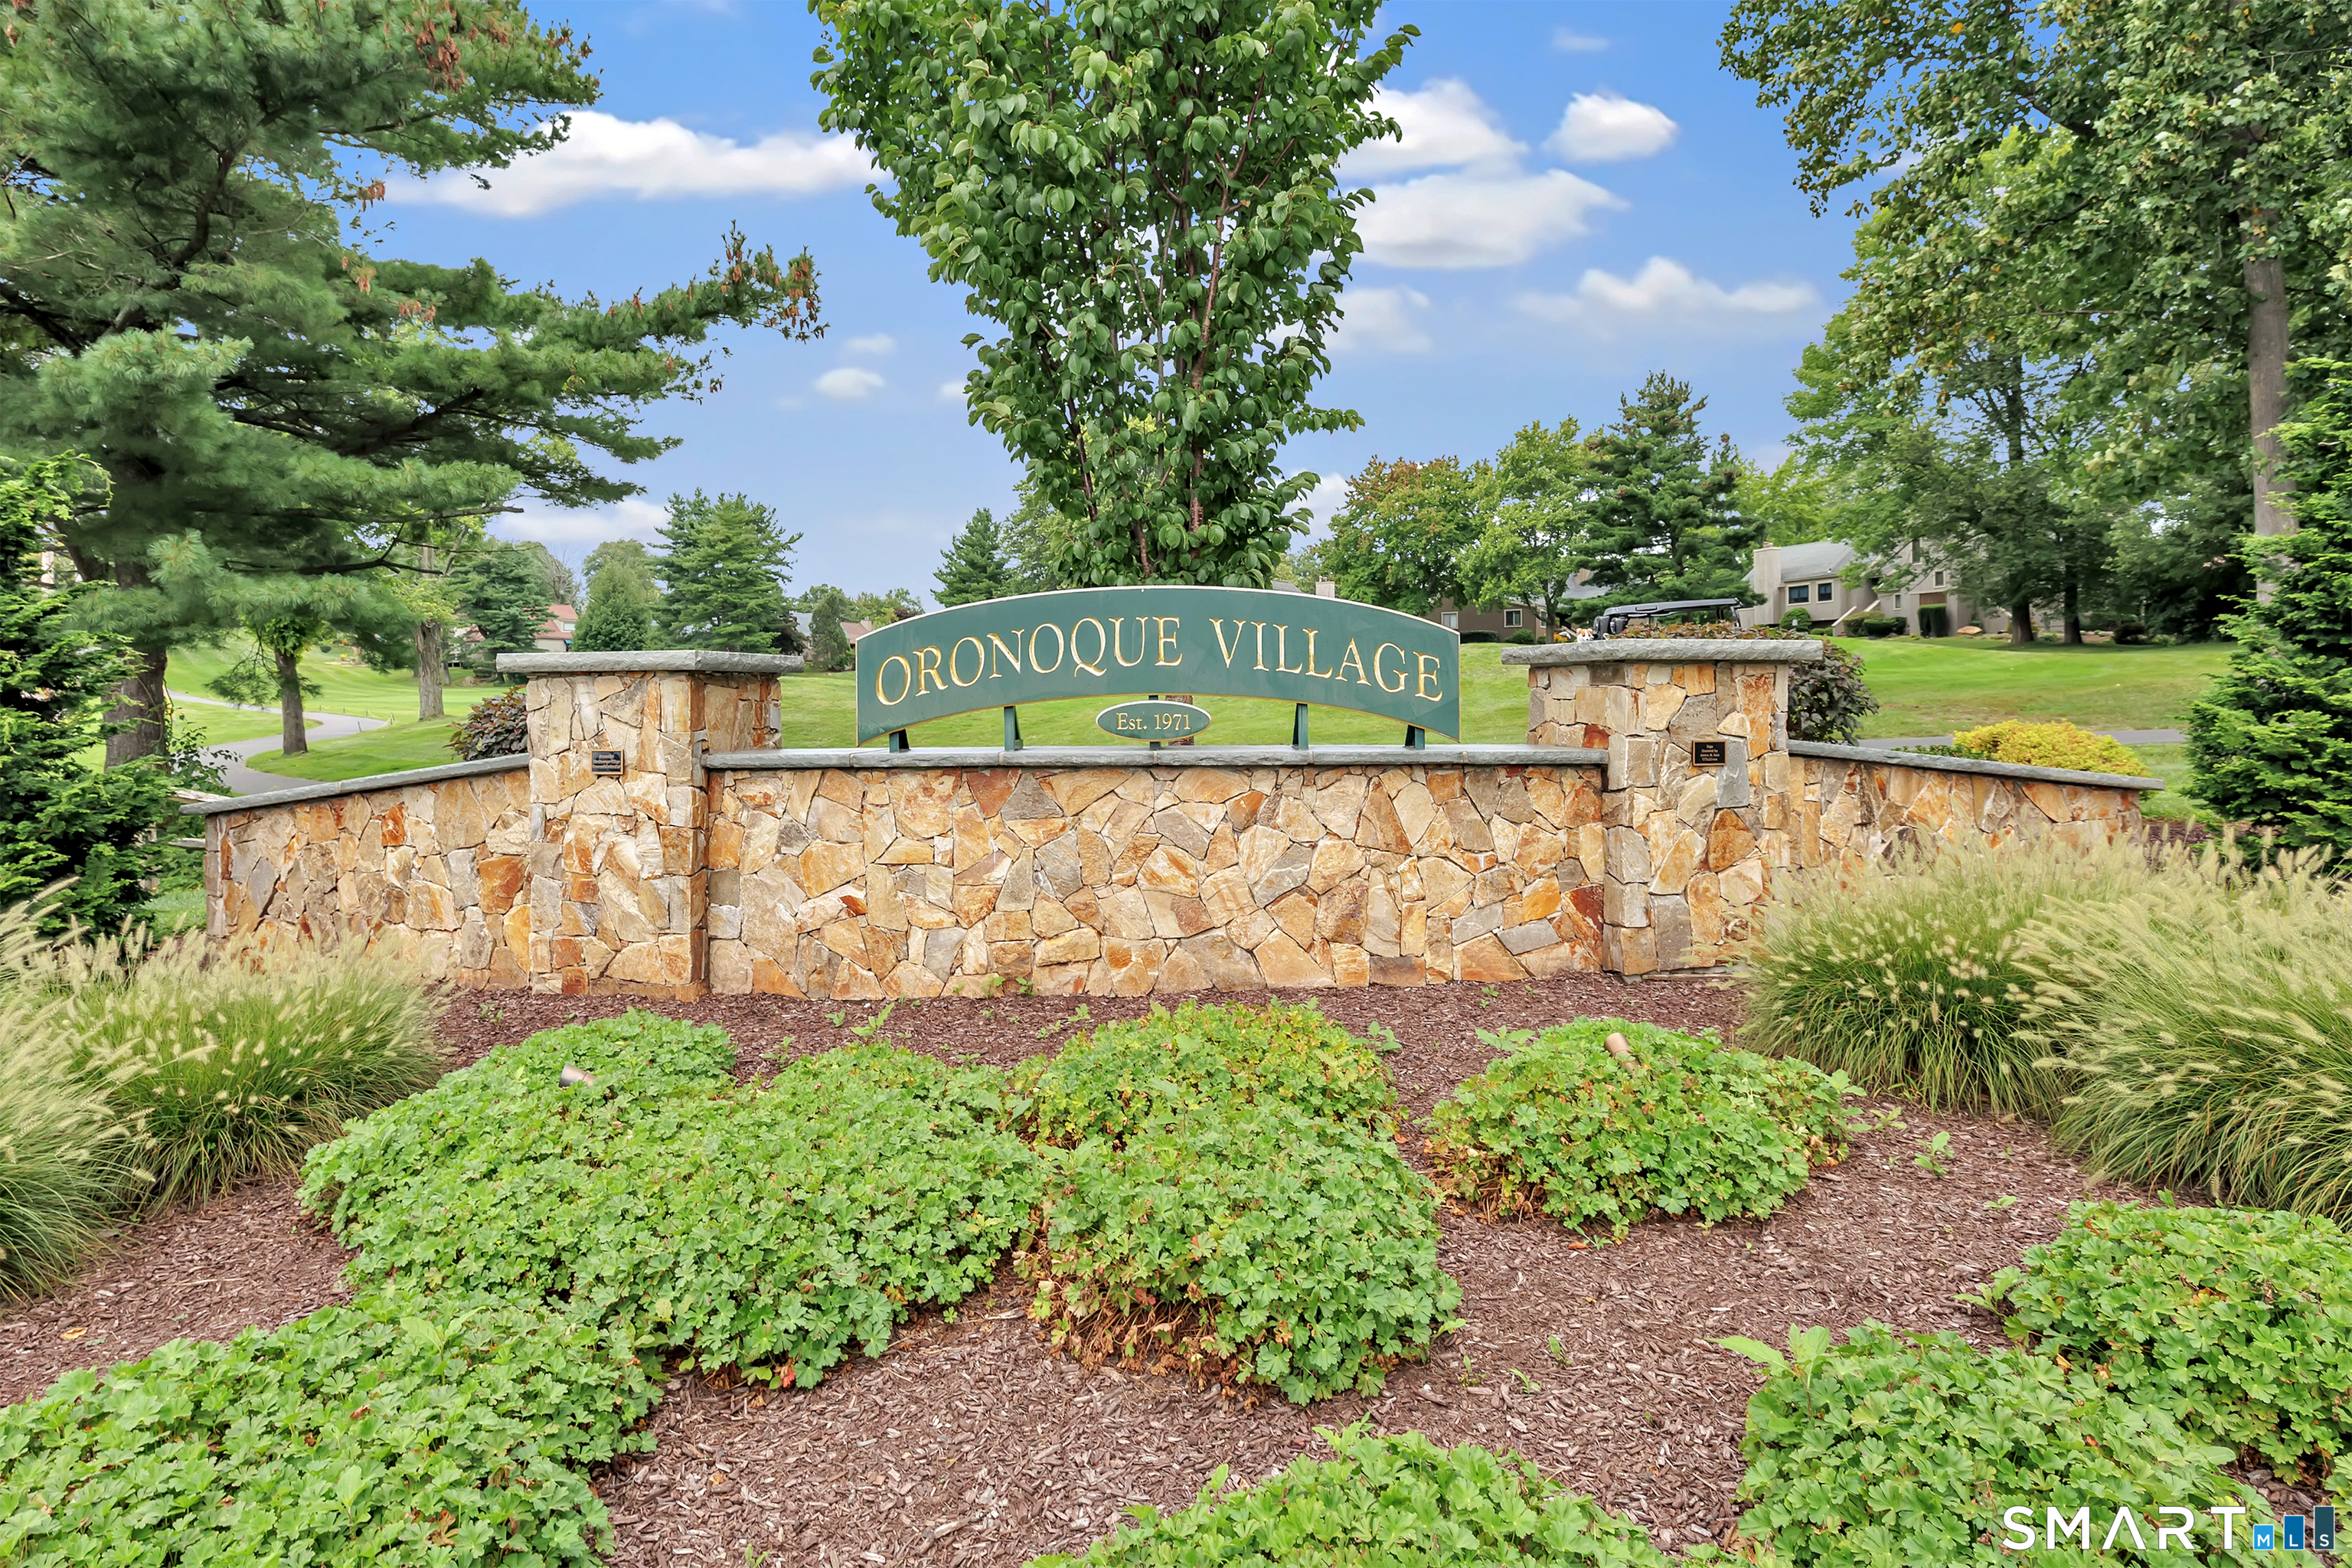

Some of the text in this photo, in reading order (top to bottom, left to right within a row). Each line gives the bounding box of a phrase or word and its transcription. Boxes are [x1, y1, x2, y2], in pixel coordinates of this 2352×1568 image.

[875, 616, 1443, 706] ORONOQUE VILLAGE
[1116, 712, 1191, 731] Est. 1971
